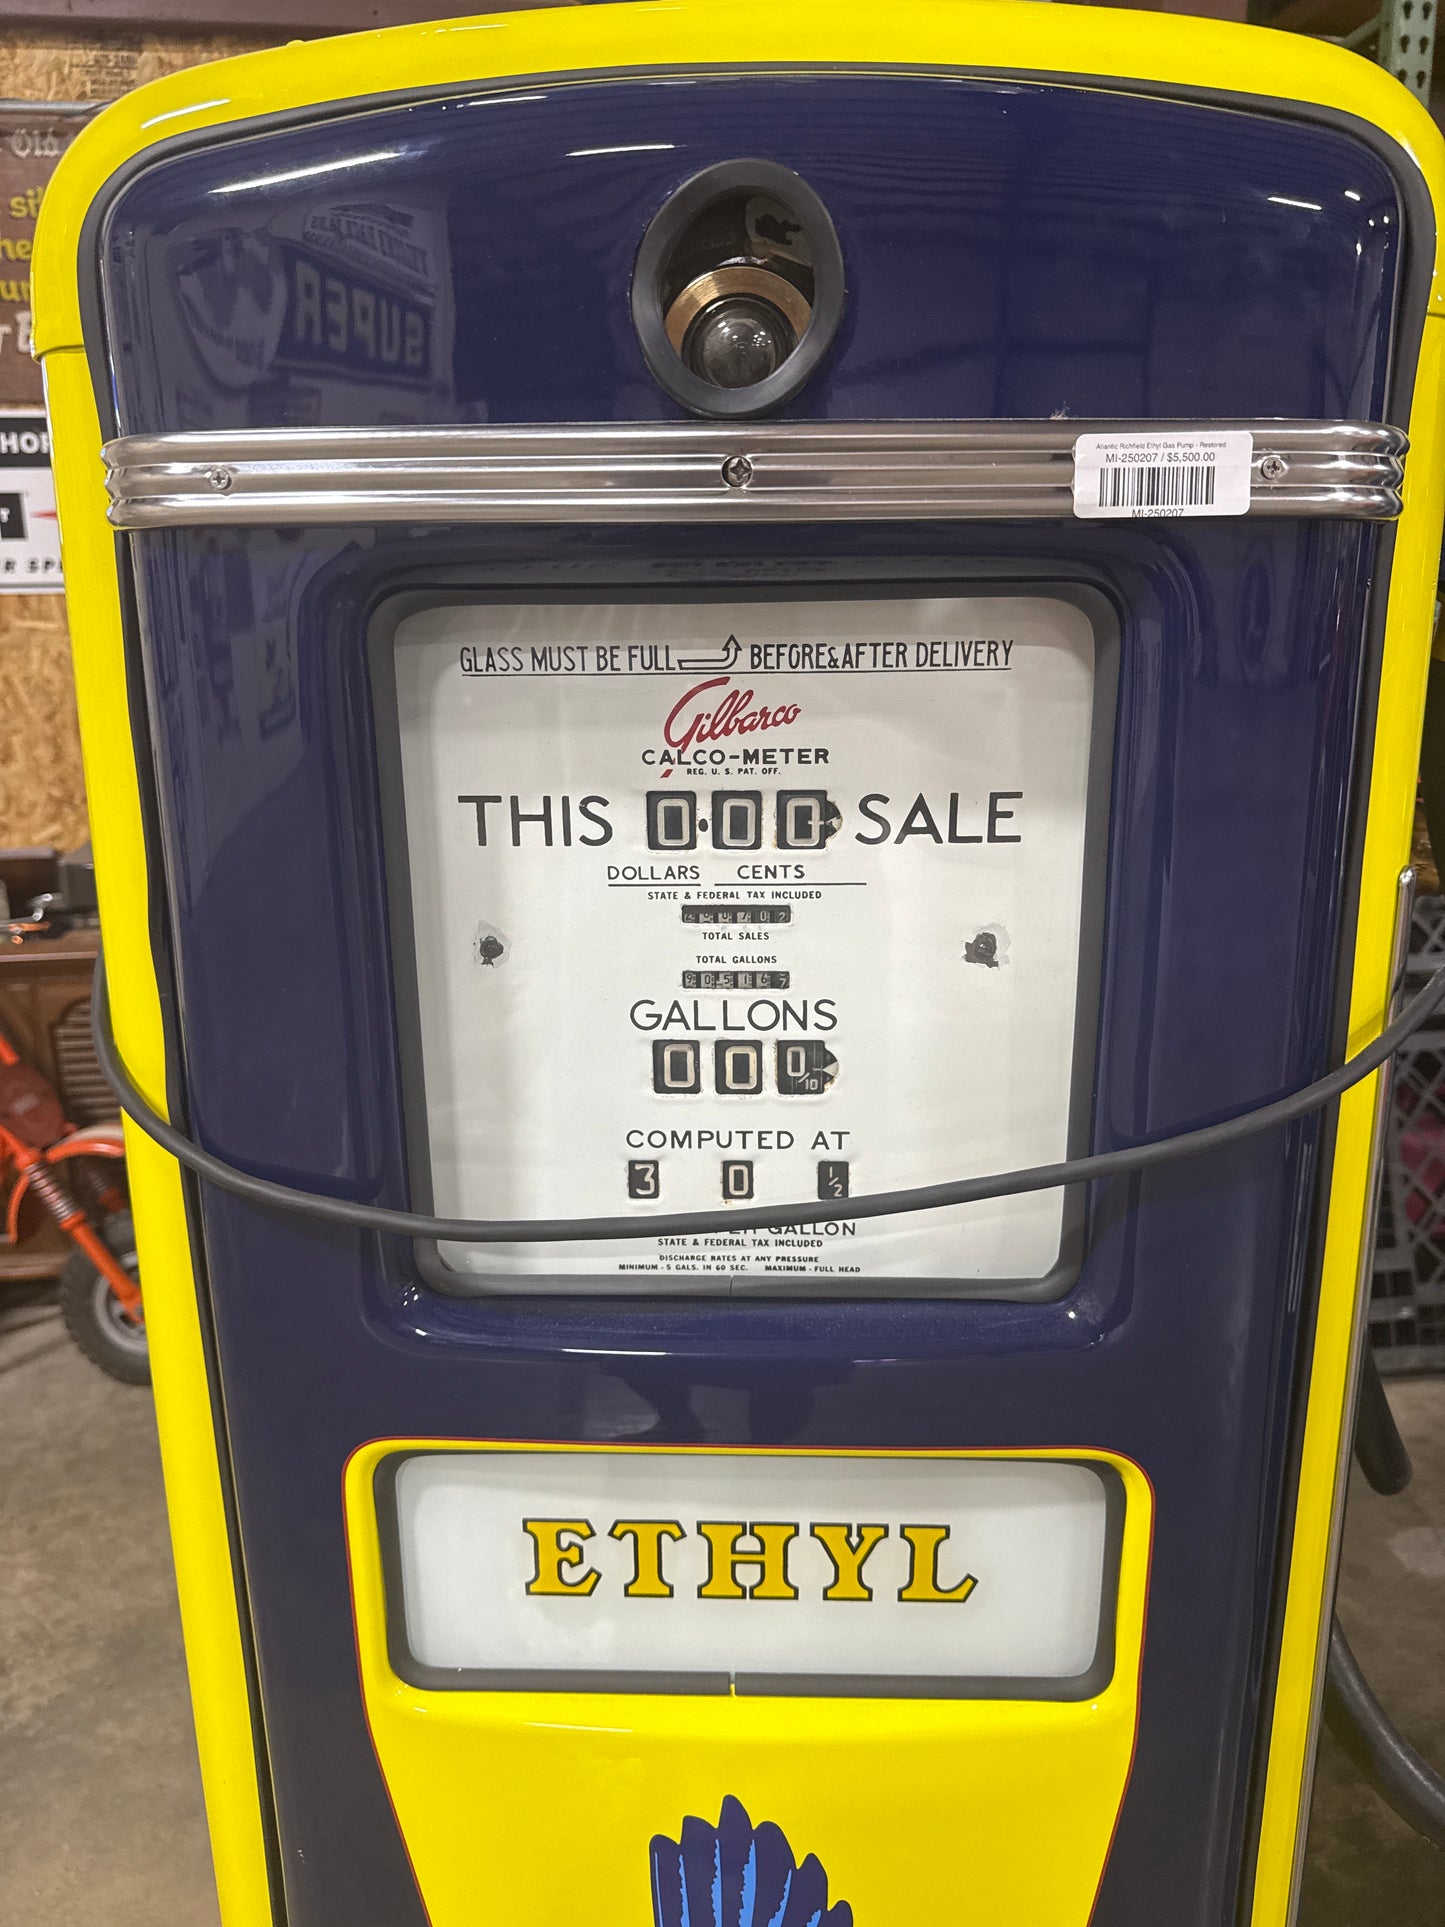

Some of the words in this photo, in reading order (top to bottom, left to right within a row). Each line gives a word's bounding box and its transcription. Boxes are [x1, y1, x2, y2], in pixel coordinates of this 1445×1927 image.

[1096, 442, 1118, 450] Atlantic
[1119, 442, 1145, 450] Richfield
[1146, 442, 1161, 450] Ethyl
[1162, 441, 1175, 449] Gas
[1177, 441, 1194, 450] Pump
[1199, 440, 1227, 448] Restored
[1105, 452, 1158, 463] MI-250207
[1166, 451, 1215, 463] $5,500.00
[1131, 508, 1185, 518] MI-250207
[460, 646, 524, 673] GLASS
[531, 645, 588, 672] MUST
[596, 645, 621, 671] BE
[628, 645, 676, 671] FULL
[915, 639, 1014, 668] DELIVERY
[663, 676, 802, 756] Gilbarco
[641, 748, 830, 766] CALCO-METER
[686, 768, 707, 776] REG.
[711, 768, 721, 776] U.
[725, 768, 734, 776] S.
[738, 767, 758, 776] PAT.
[761, 767, 781, 776] OFF.
[458, 795, 613, 846] THIS
[855, 792, 1023, 845] SALE
[607, 865, 700, 880] DOLLARS
[737, 864, 805, 880] CENTS
[648, 891, 678, 900] STATE
[684, 891, 692, 900] &
[696, 891, 740, 900] FEDERAL
[747, 891, 766, 900] TAX
[771, 890, 822, 900] INCLUDED
[702, 931, 733, 941] TOTAL
[738, 931, 770, 941] SALES
[696, 955, 727, 964] TOTAL
[732, 955, 777, 964] GALLONS
[630, 999, 837, 1031] GALLONS
[626, 1130, 794, 1149] COMPUTED
[811, 1131, 850, 1150] AT
[634, 1163, 655, 1195] 3
[729, 1164, 749, 1195] 0
[657, 1238, 687, 1246] STATE
[692, 1238, 700, 1246] &
[704, 1238, 746, 1247] FEDERAL
[751, 1238, 769, 1247] TAX
[774, 1238, 823, 1248] INCLUDED
[659, 1254, 706, 1262] DISCHARGE
[755, 1255, 772, 1263] ANY
[522, 1517, 979, 1603] ETHYL
